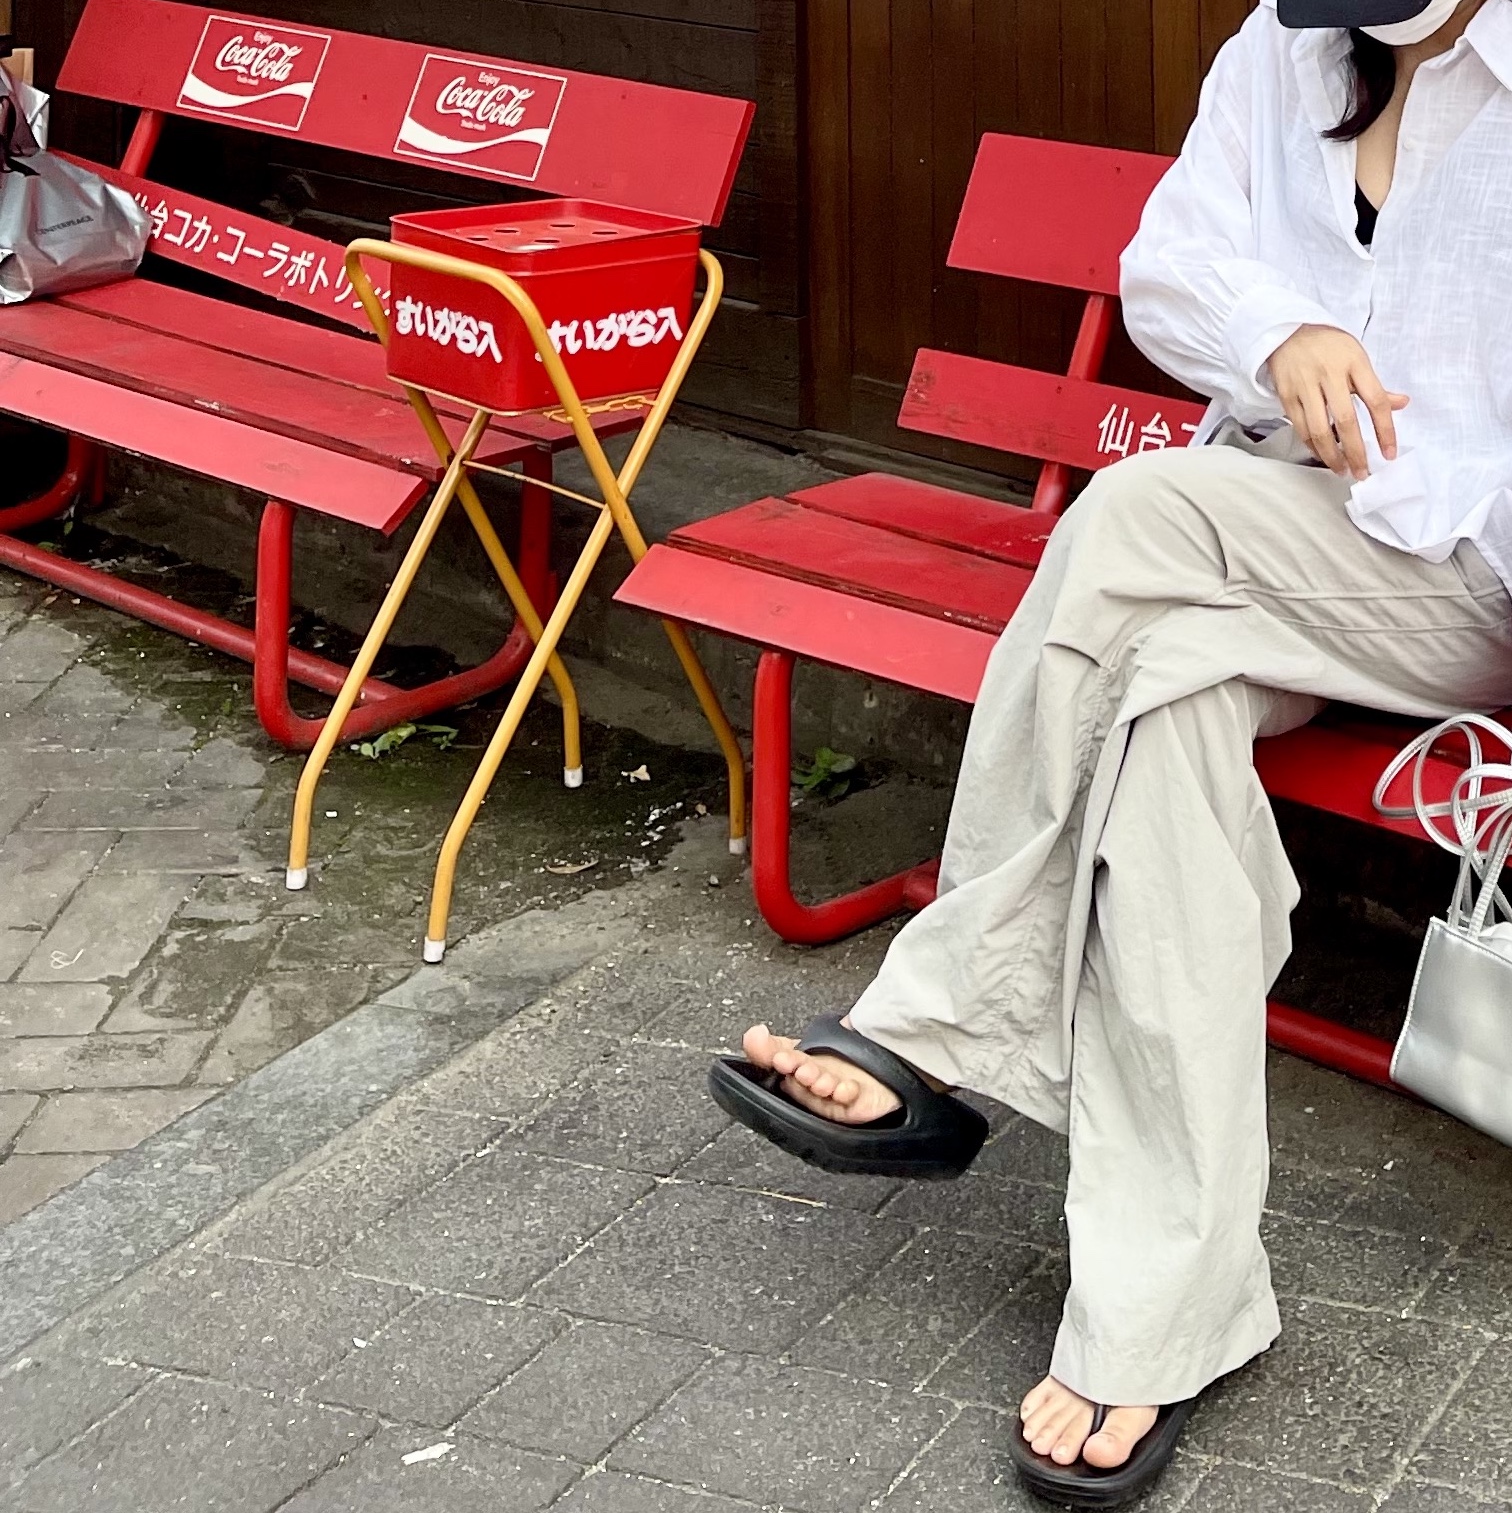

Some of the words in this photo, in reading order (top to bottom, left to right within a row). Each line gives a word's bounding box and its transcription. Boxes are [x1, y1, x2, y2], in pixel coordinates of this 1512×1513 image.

[215, 35, 303, 82] Coca-Cola
[478, 71, 500, 87] Enjoy
[435, 76, 536, 127] Coca-Cola
[135, 192, 390, 315] 台コカ・コーラボトリ
[396, 295, 503, 364] すいがら入
[1097, 403, 1200, 458] 仙台
